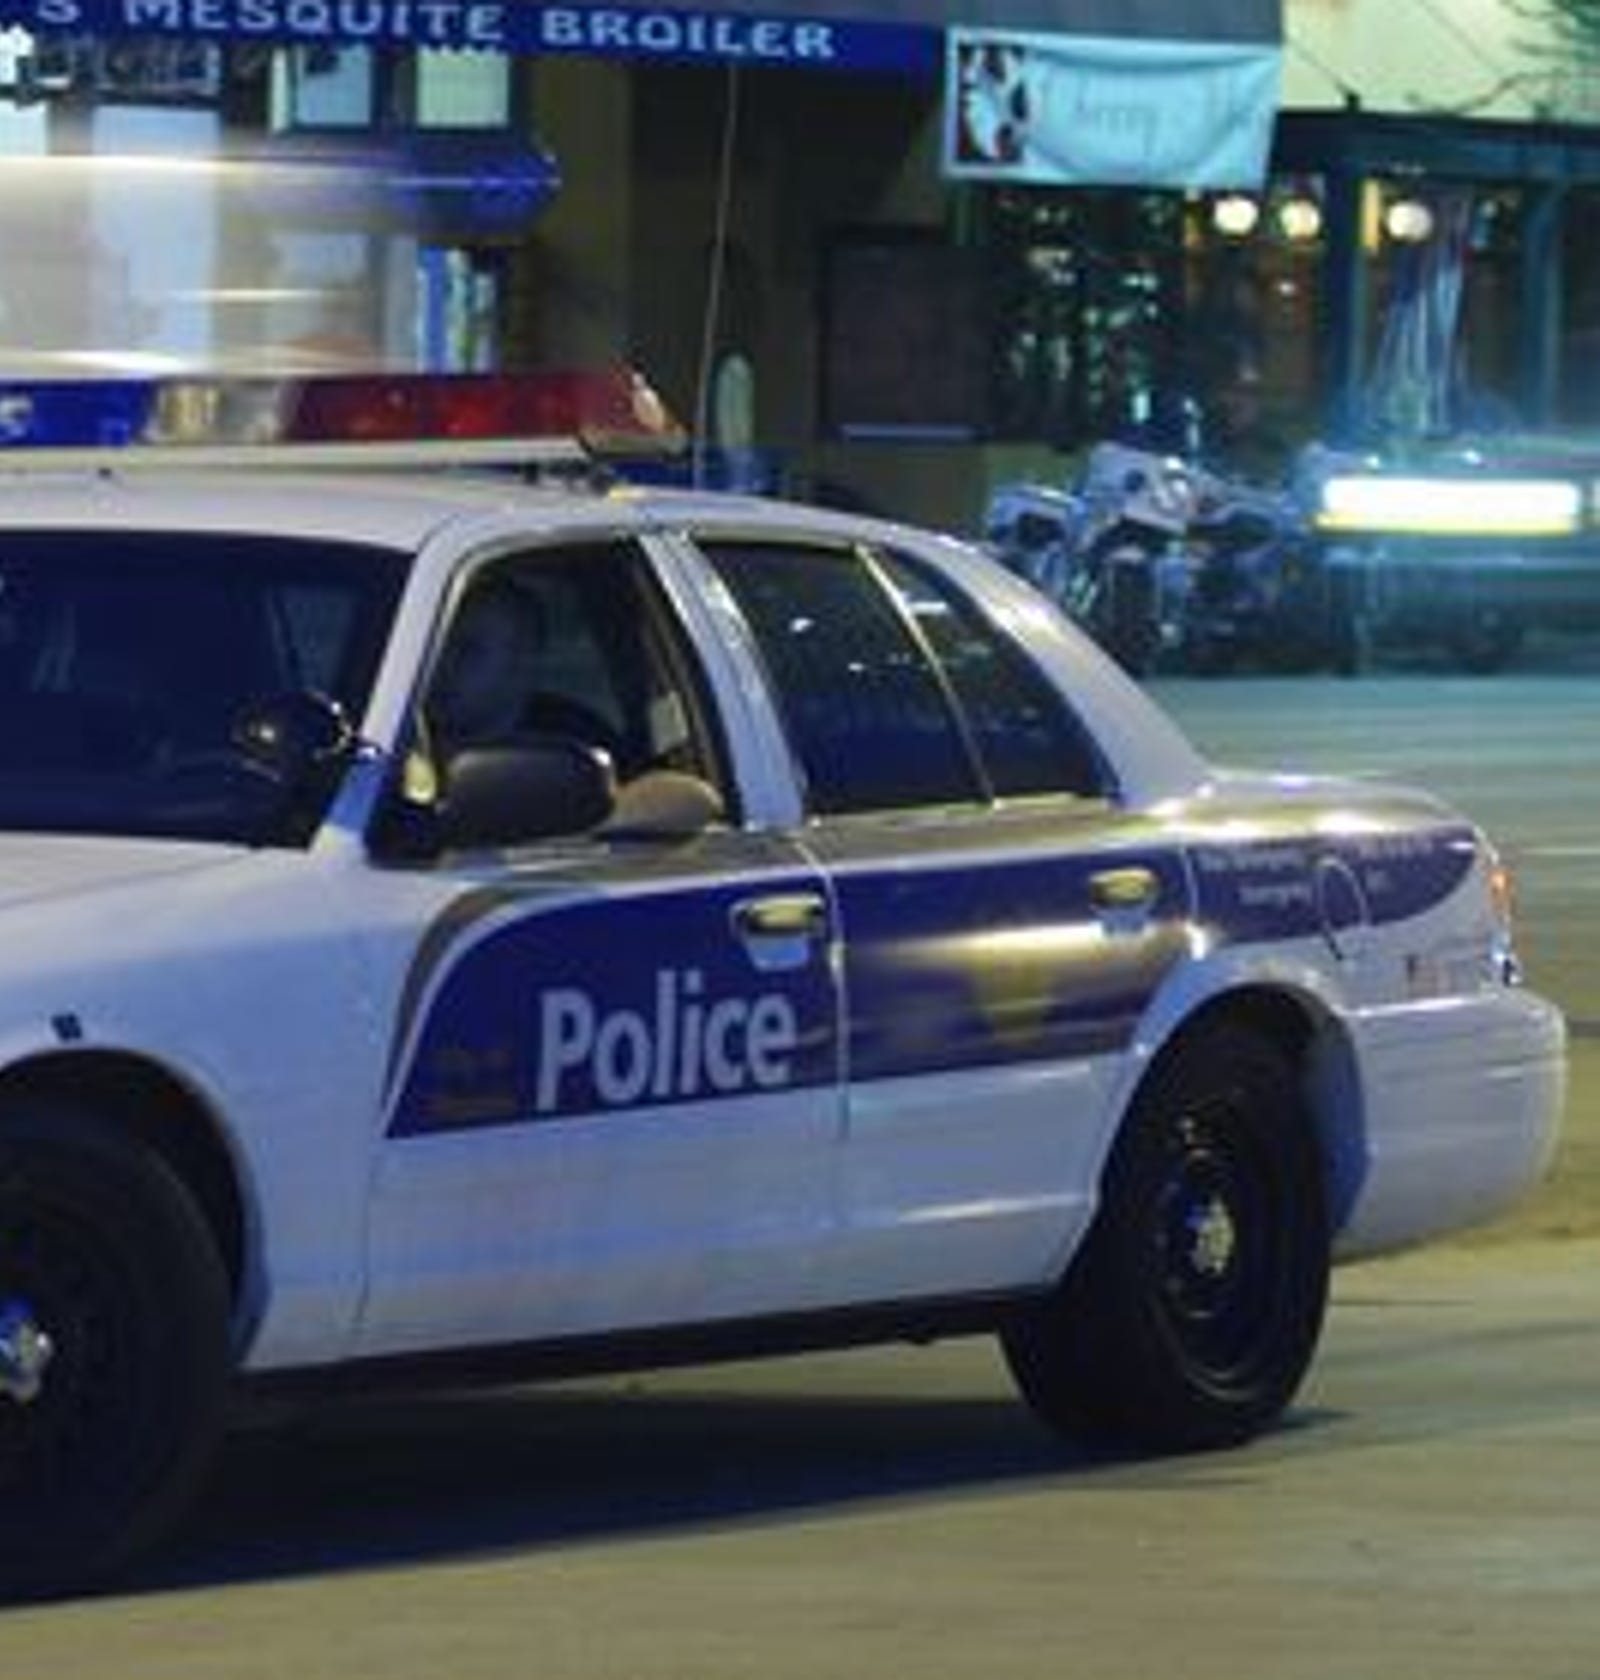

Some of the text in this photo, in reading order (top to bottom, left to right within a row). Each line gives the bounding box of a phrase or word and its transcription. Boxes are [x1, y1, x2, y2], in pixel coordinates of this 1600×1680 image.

[123, 0, 504, 39] MESQUITE
[541, 9, 836, 58] BROILER
[536, 969, 797, 1112] Police
